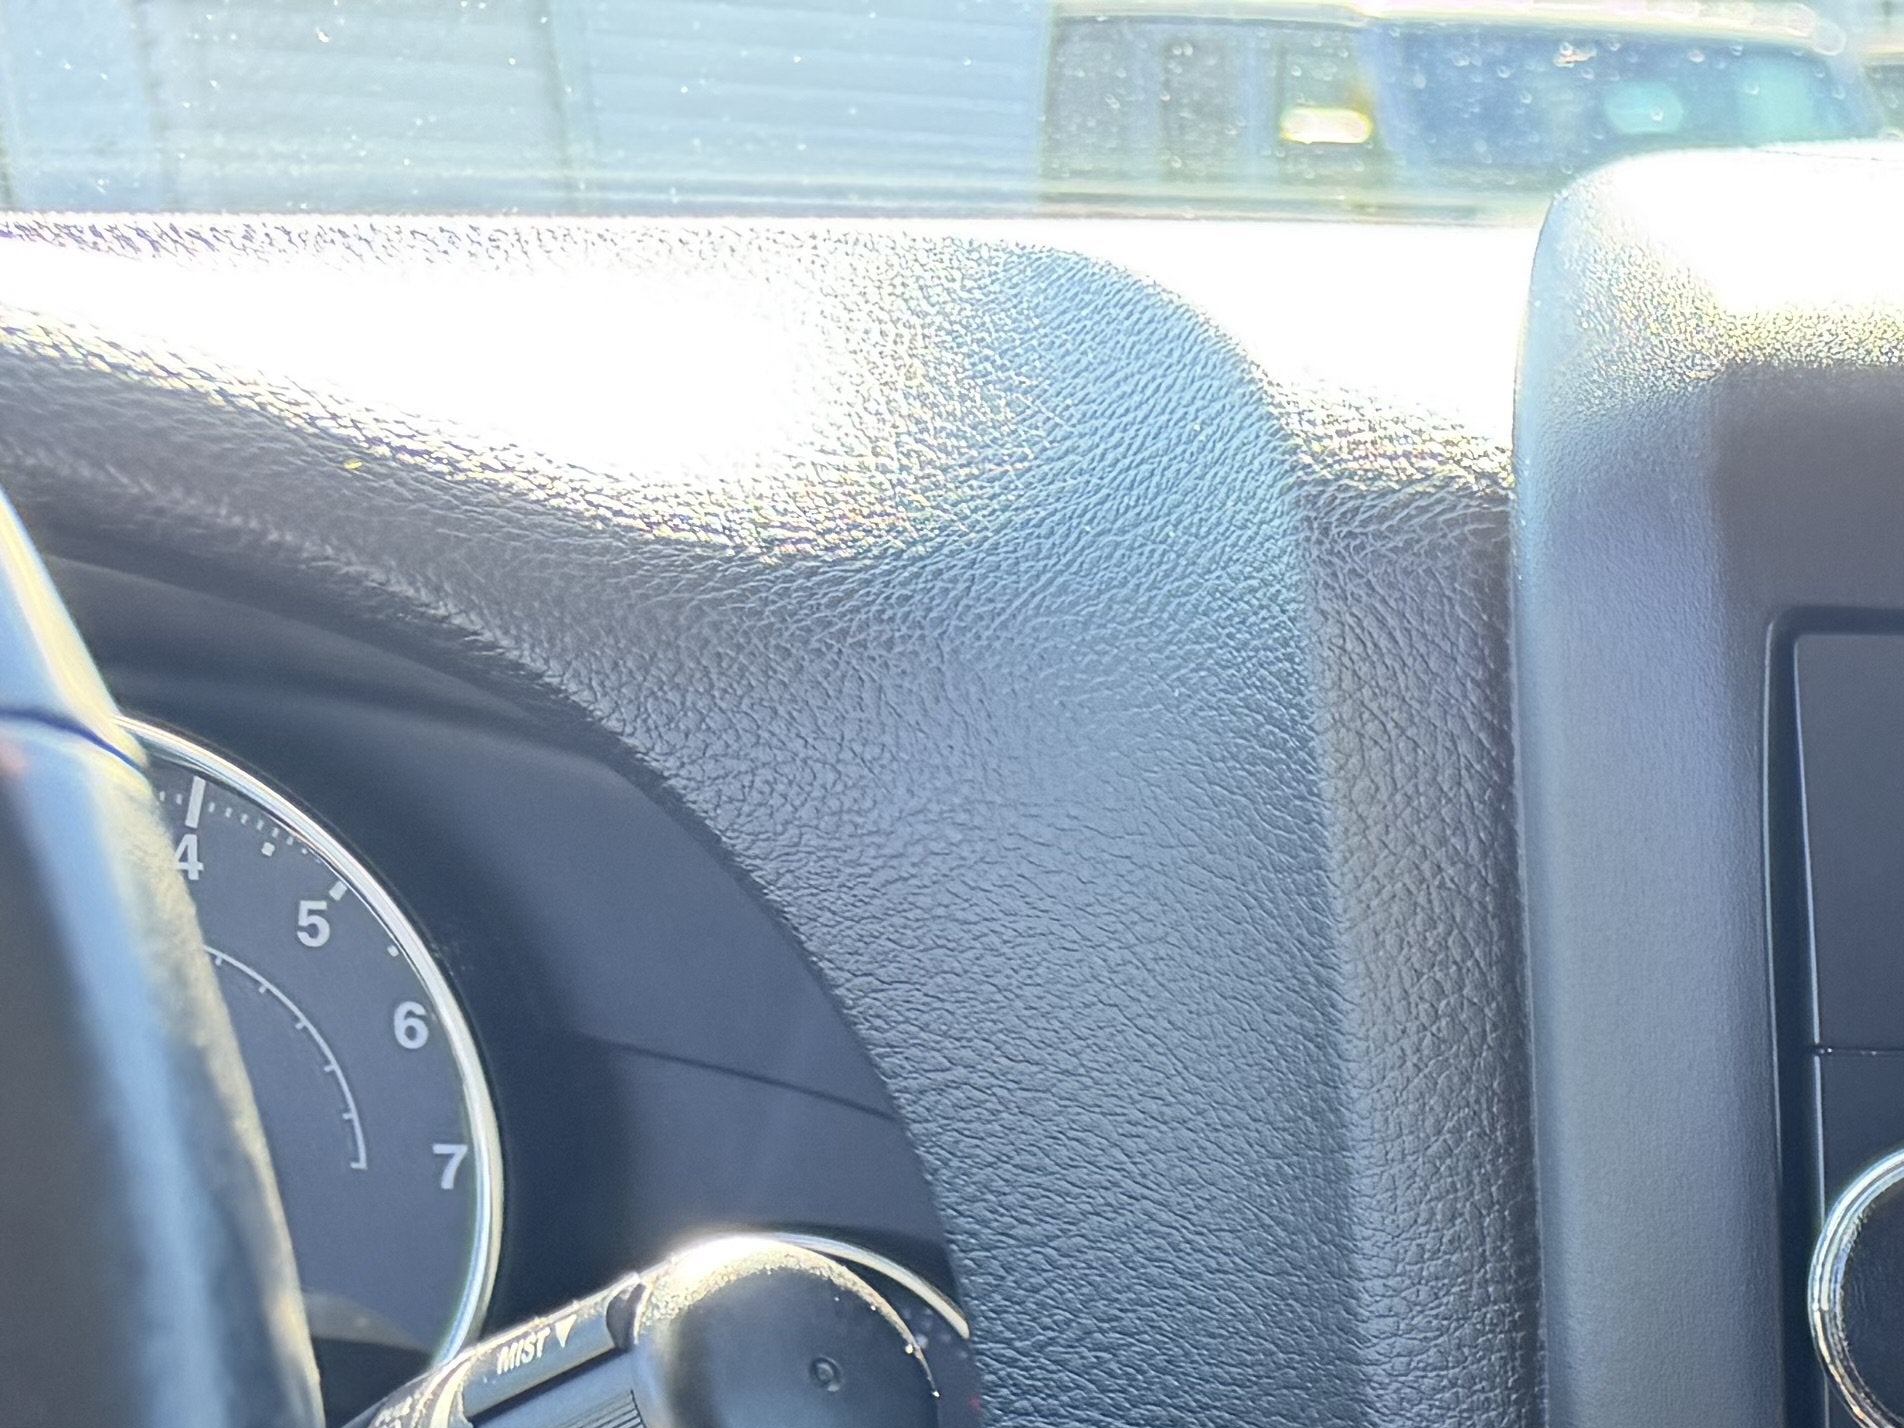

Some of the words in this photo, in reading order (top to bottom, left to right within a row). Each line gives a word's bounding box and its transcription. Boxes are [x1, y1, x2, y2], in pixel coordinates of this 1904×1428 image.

[174, 834, 205, 881] 4
[296, 900, 331, 948] 5
[393, 1001, 429, 1049] 6
[433, 1144, 468, 1189] 7
[496, 1326, 551, 1375] MIST
